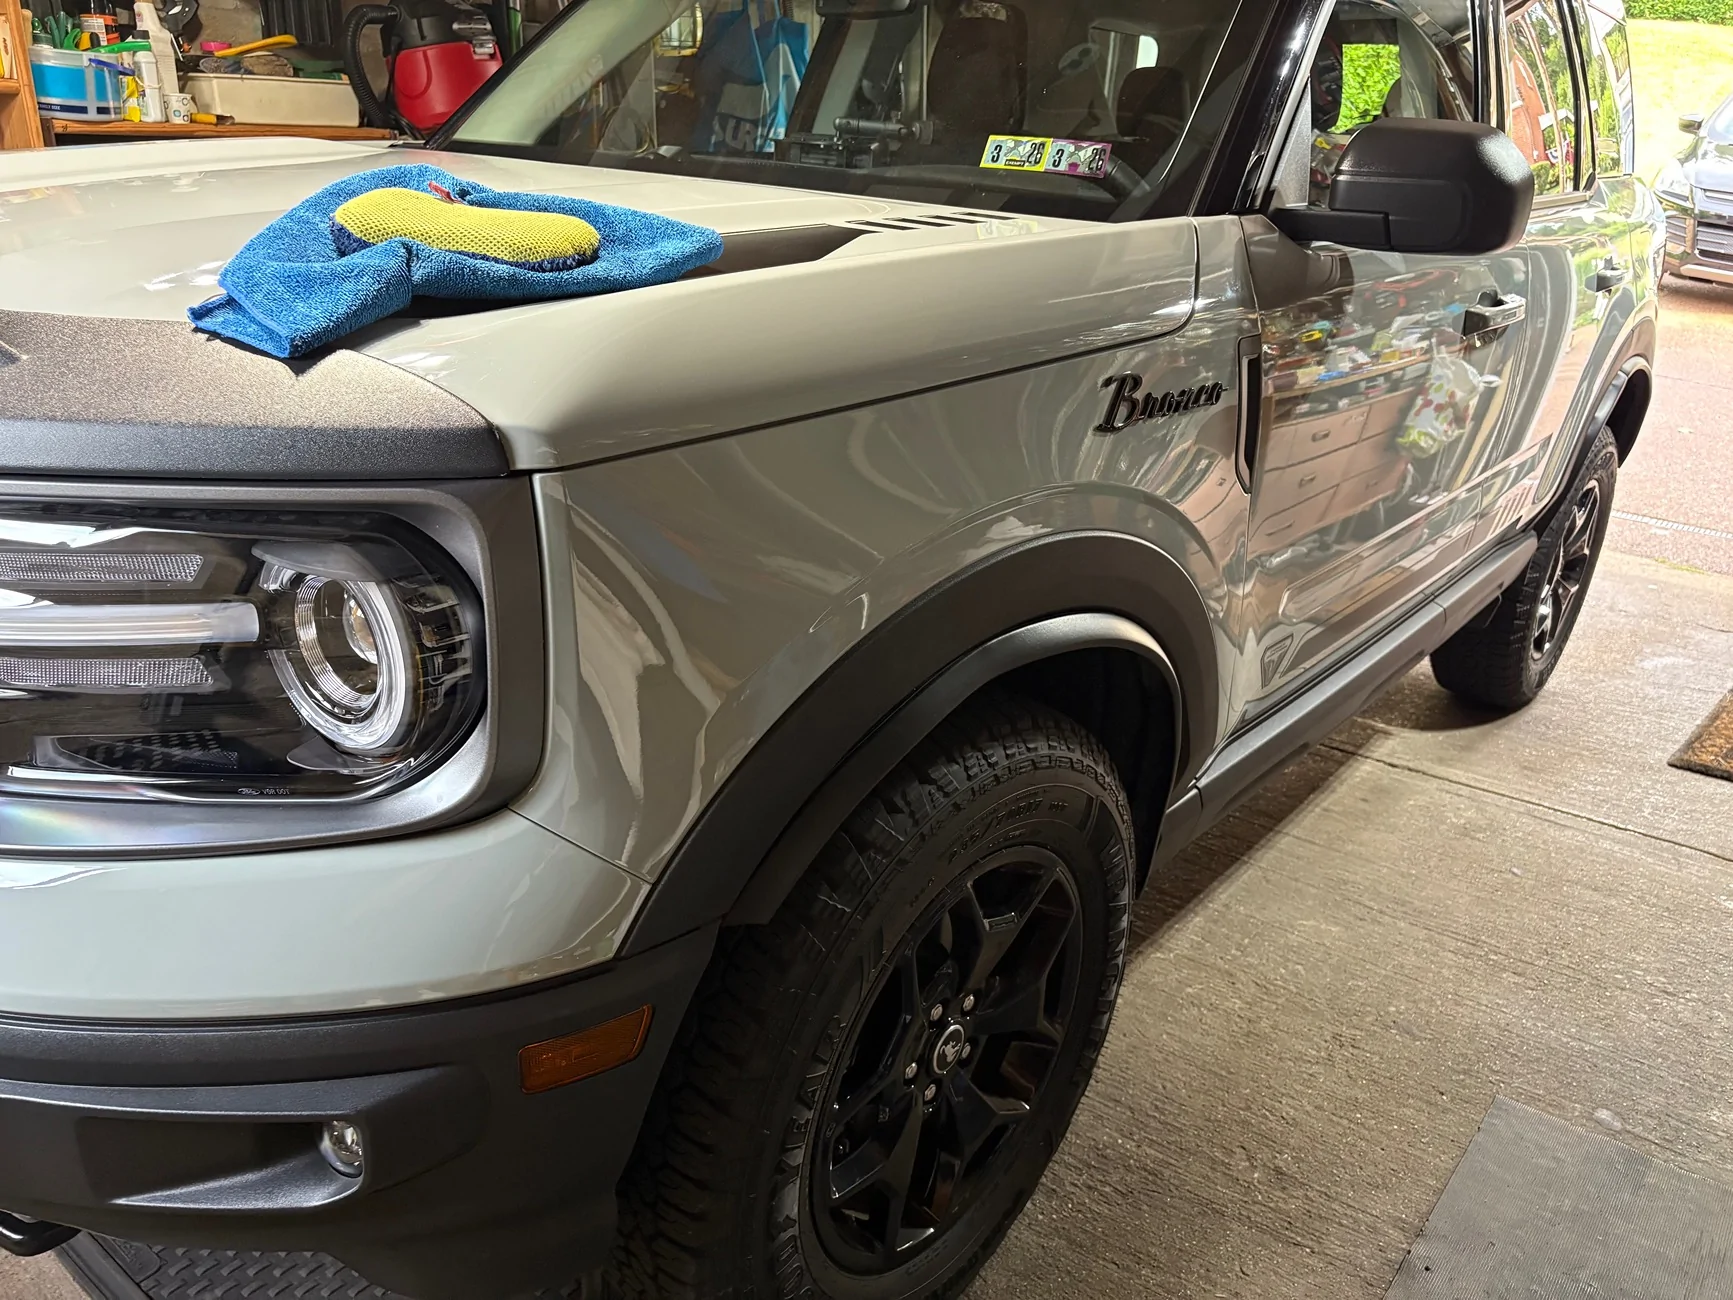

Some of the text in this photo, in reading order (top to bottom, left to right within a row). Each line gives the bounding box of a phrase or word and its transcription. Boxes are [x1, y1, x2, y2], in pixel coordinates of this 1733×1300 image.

[991, 142, 1045, 164] 3 26
[1052, 147, 1106, 171] 3 26
[1093, 371, 1230, 433] Bronco
